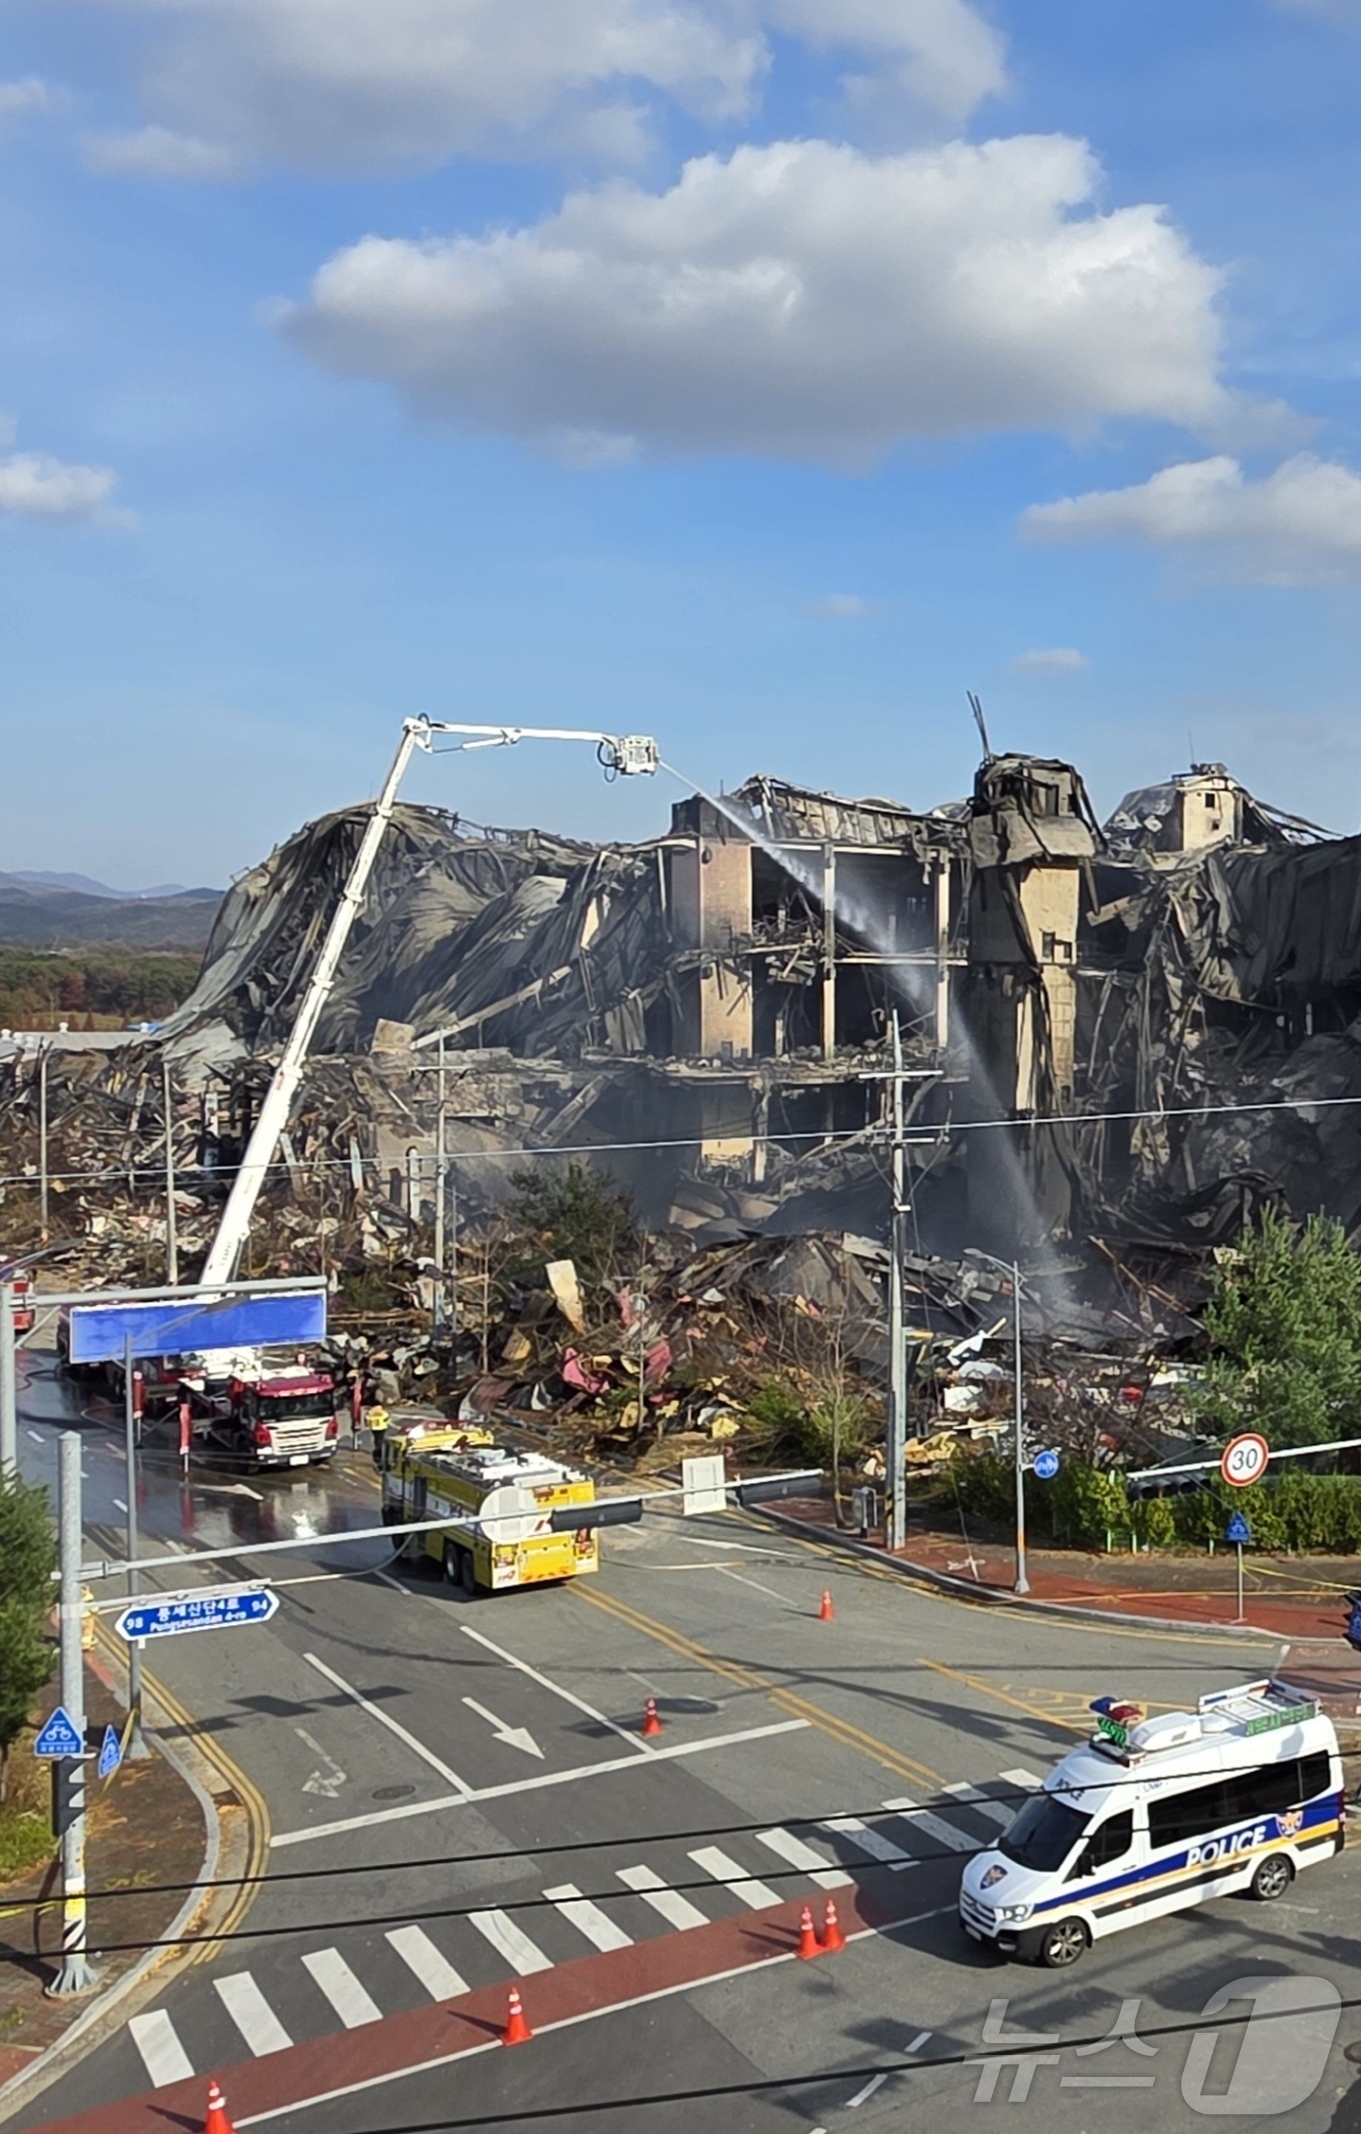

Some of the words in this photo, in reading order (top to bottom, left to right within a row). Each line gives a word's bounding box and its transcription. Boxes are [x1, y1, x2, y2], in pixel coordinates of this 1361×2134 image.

[1232, 1448, 1258, 1471] 30
[251, 1599, 268, 1613] 94
[225, 1611, 247, 1621] 4-ro
[127, 1617, 144, 1630] 98
[1185, 1826, 1266, 1868] POLICE
